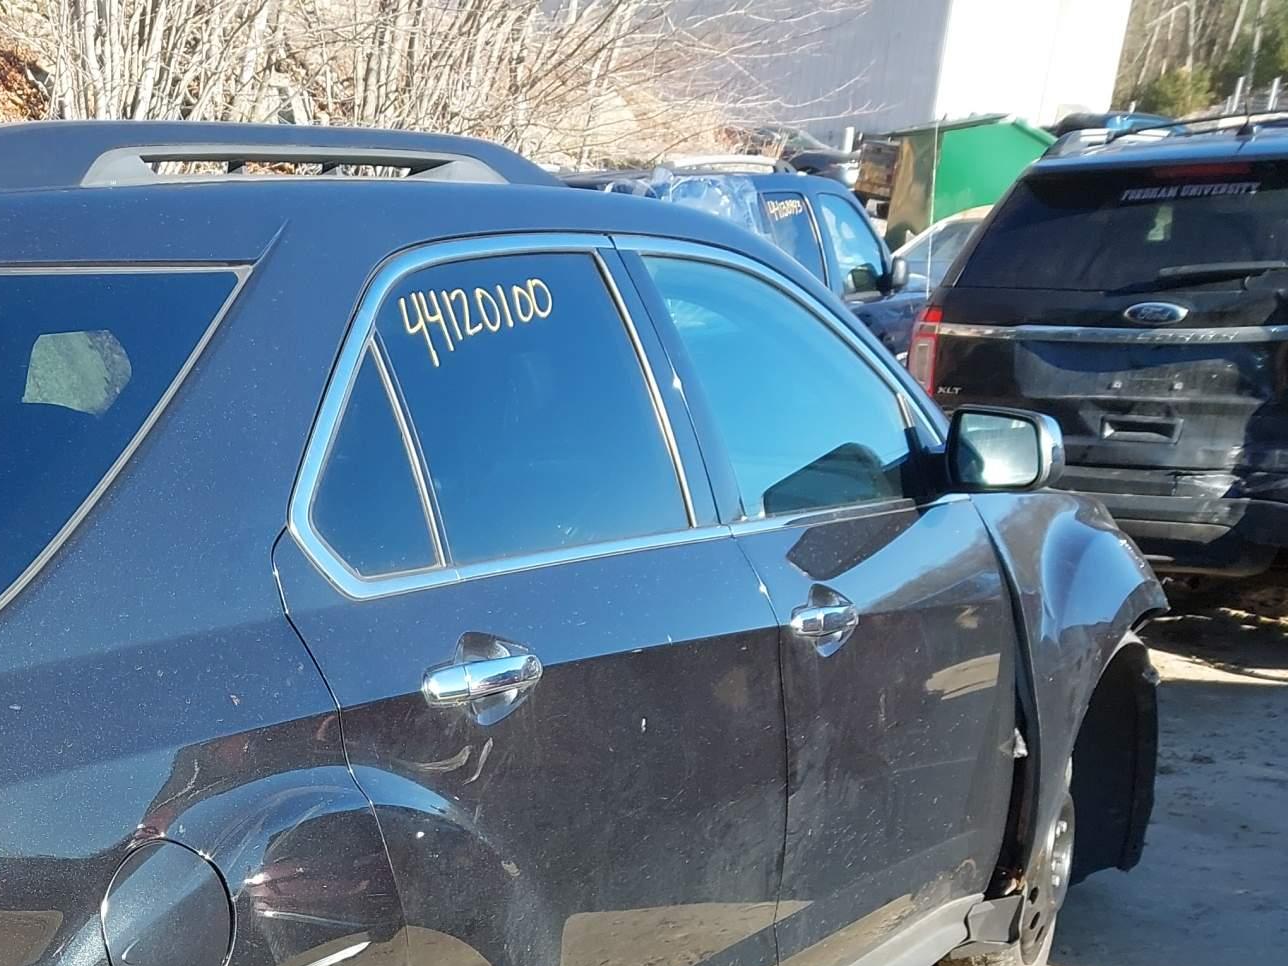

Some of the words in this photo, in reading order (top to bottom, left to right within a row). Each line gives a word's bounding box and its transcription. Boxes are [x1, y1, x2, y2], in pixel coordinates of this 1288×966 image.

[1180, 181, 1262, 197] UNIVERSITY
[399, 278, 554, 368] 44120100
[937, 386, 963, 395] XLT
